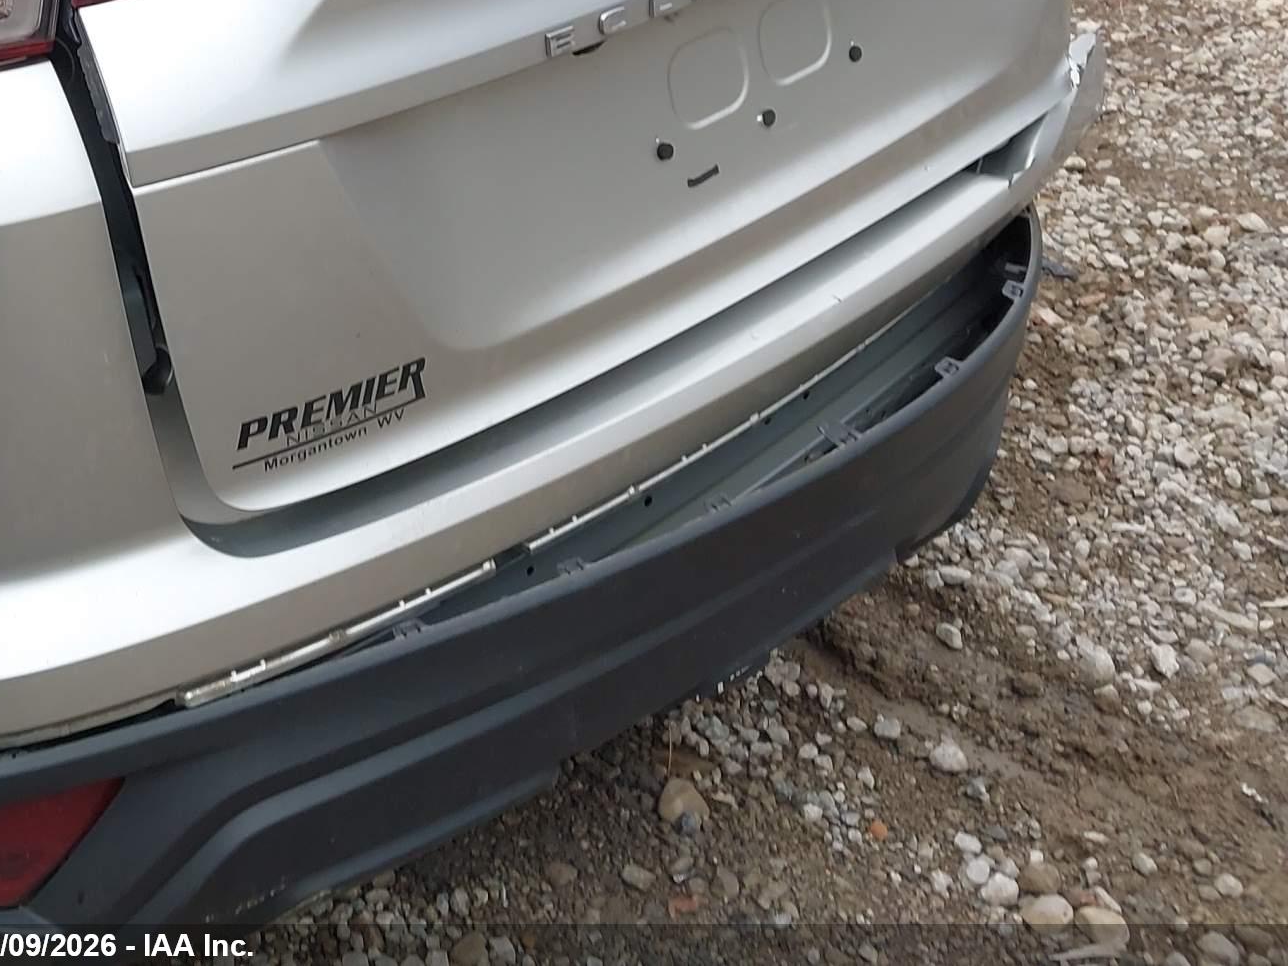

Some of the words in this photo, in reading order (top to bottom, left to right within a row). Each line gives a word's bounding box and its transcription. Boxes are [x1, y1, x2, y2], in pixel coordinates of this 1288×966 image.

[237, 356, 426, 451] PREMIER
[264, 426, 368, 472] Morgantown
[377, 408, 405, 429] WV
